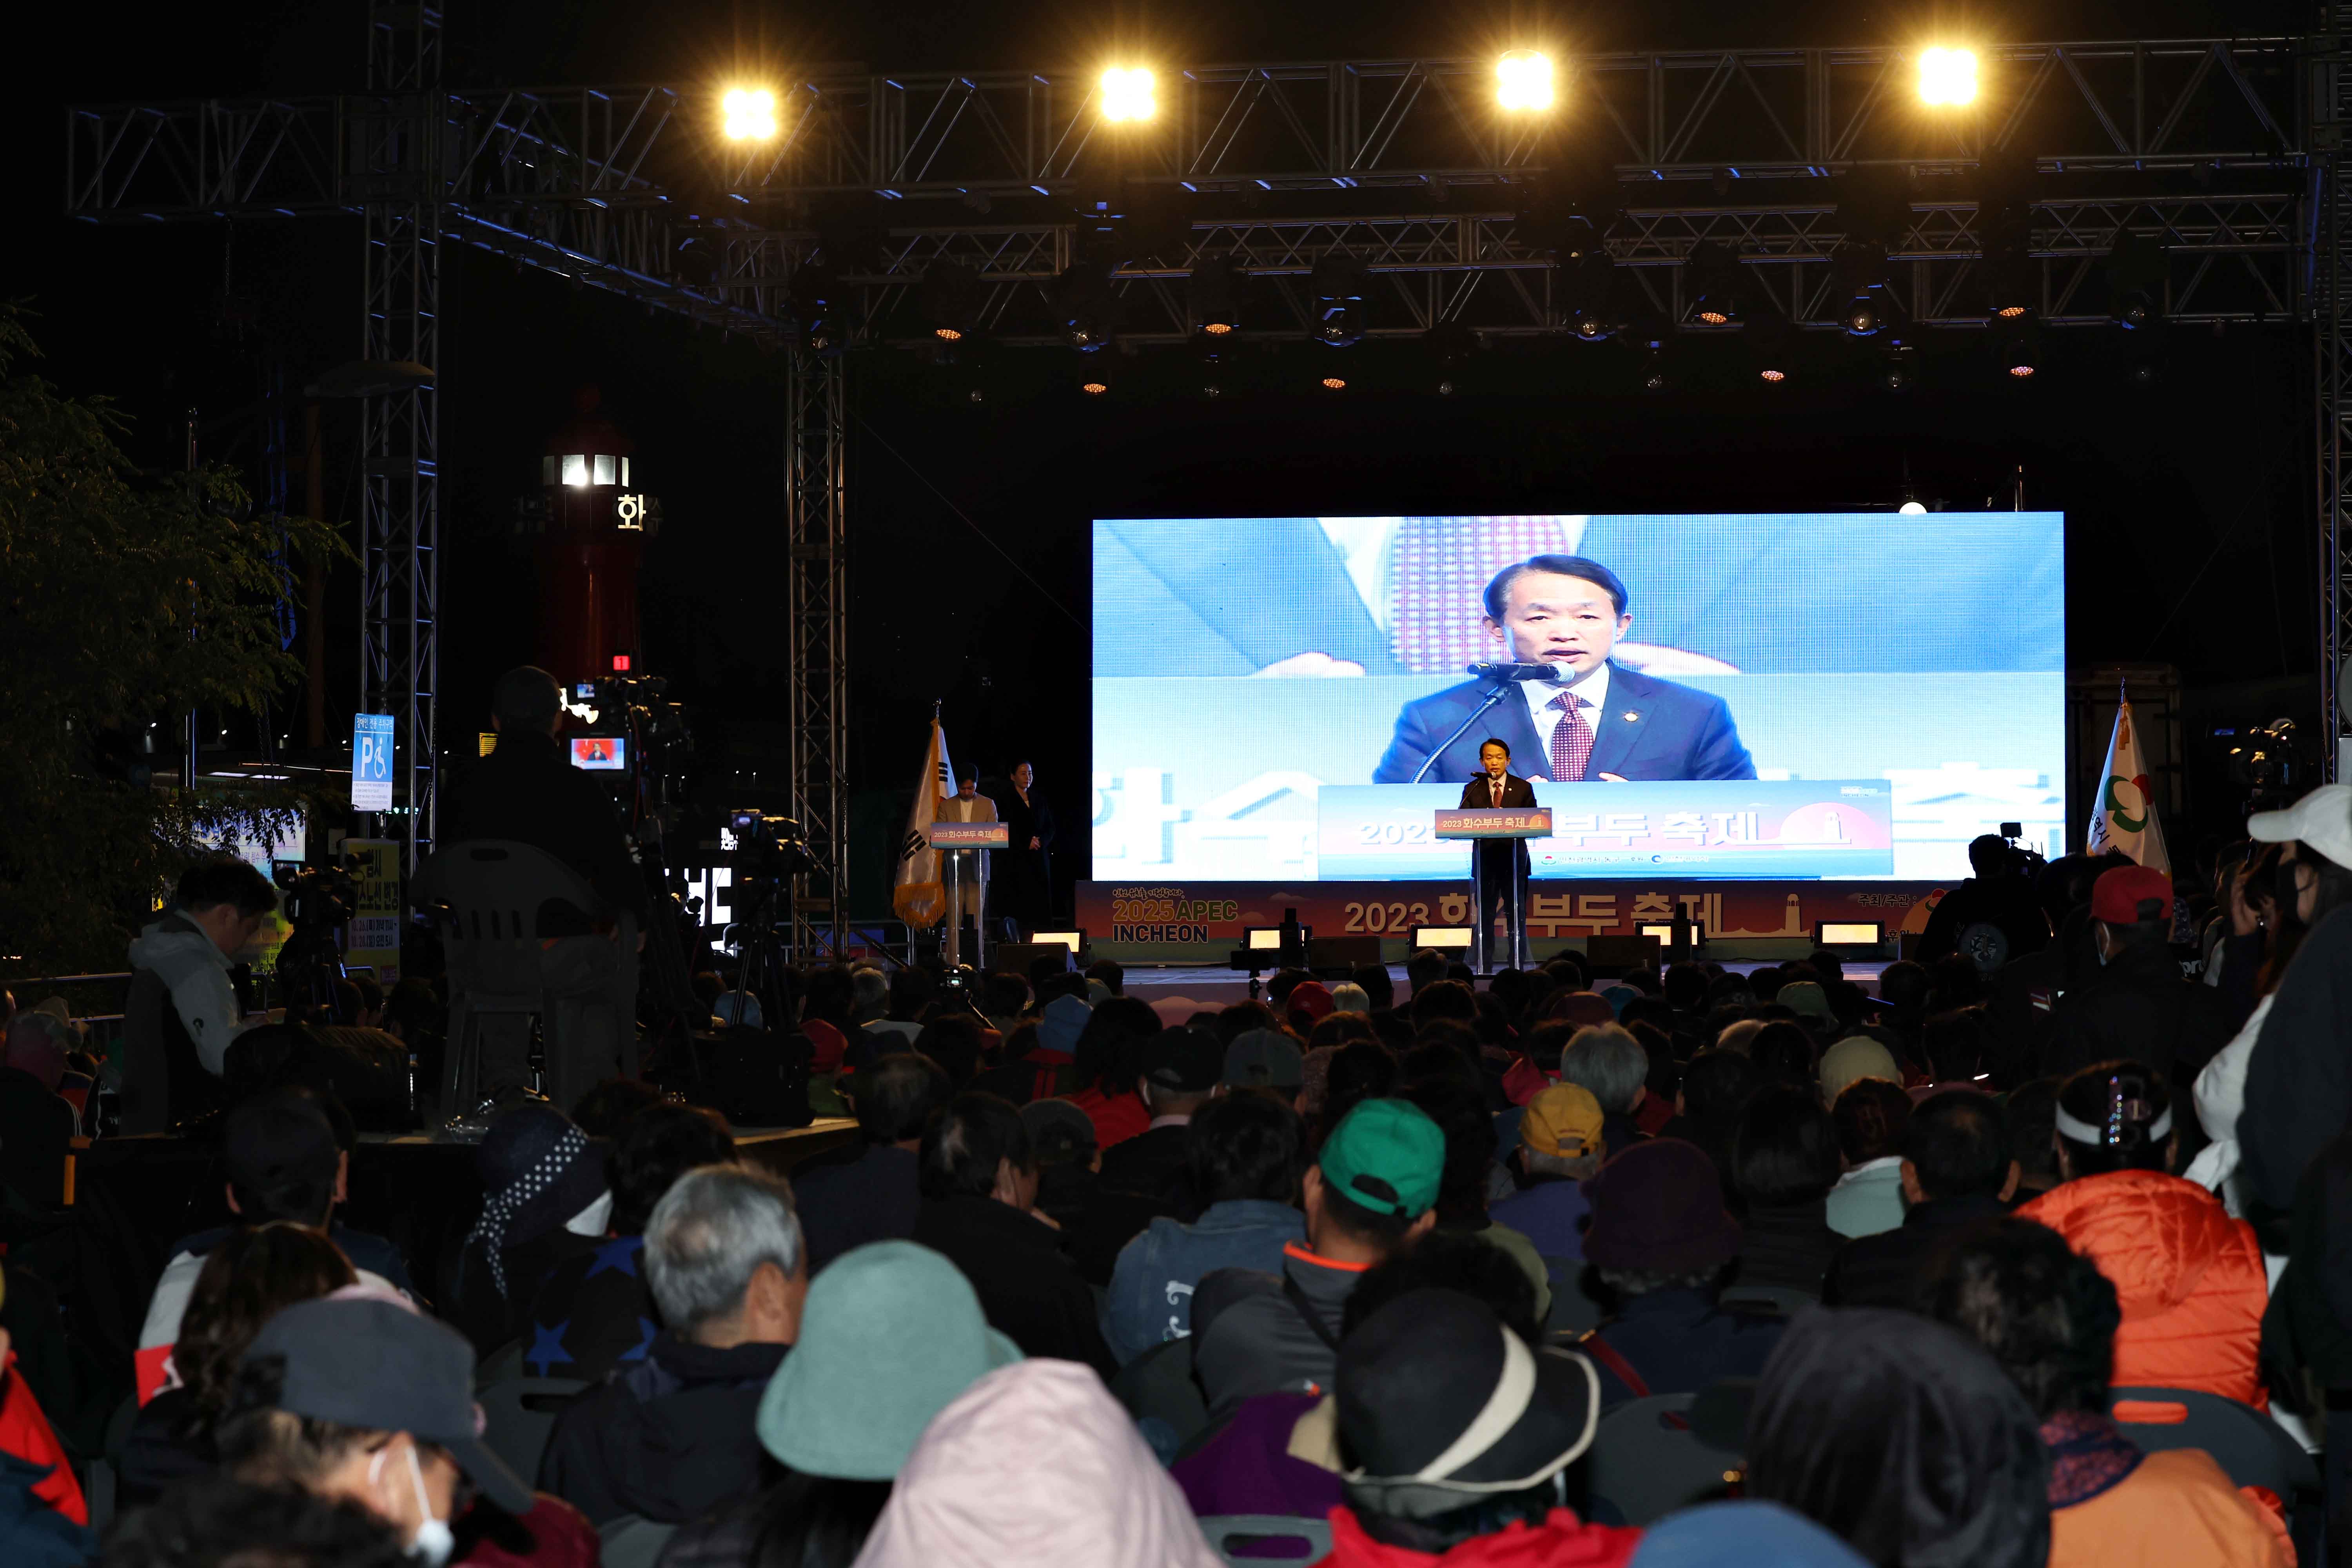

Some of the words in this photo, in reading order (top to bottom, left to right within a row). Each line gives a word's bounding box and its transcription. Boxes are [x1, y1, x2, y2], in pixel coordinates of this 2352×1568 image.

[357, 717, 368, 729] 장애인
[370, 718, 377, 729] 전용
[379, 719, 393, 730] 주차구역
[361, 737, 373, 778] P
[1360, 819, 1439, 847] 202
[1661, 811, 1760, 846] 축제
[1442, 820, 1462, 828] 2023
[1463, 817, 1503, 829] 화수부두
[1504, 817, 1525, 828] 축제
[357, 881, 381, 910] 스노선
[1113, 888, 1128, 898] 인천
[1128, 887, 1148, 900] 유치를
[1858, 893, 1910, 907] 주최/주관
[1345, 902, 1429, 933] 2023
[1113, 924, 1208, 943] INCHEON
